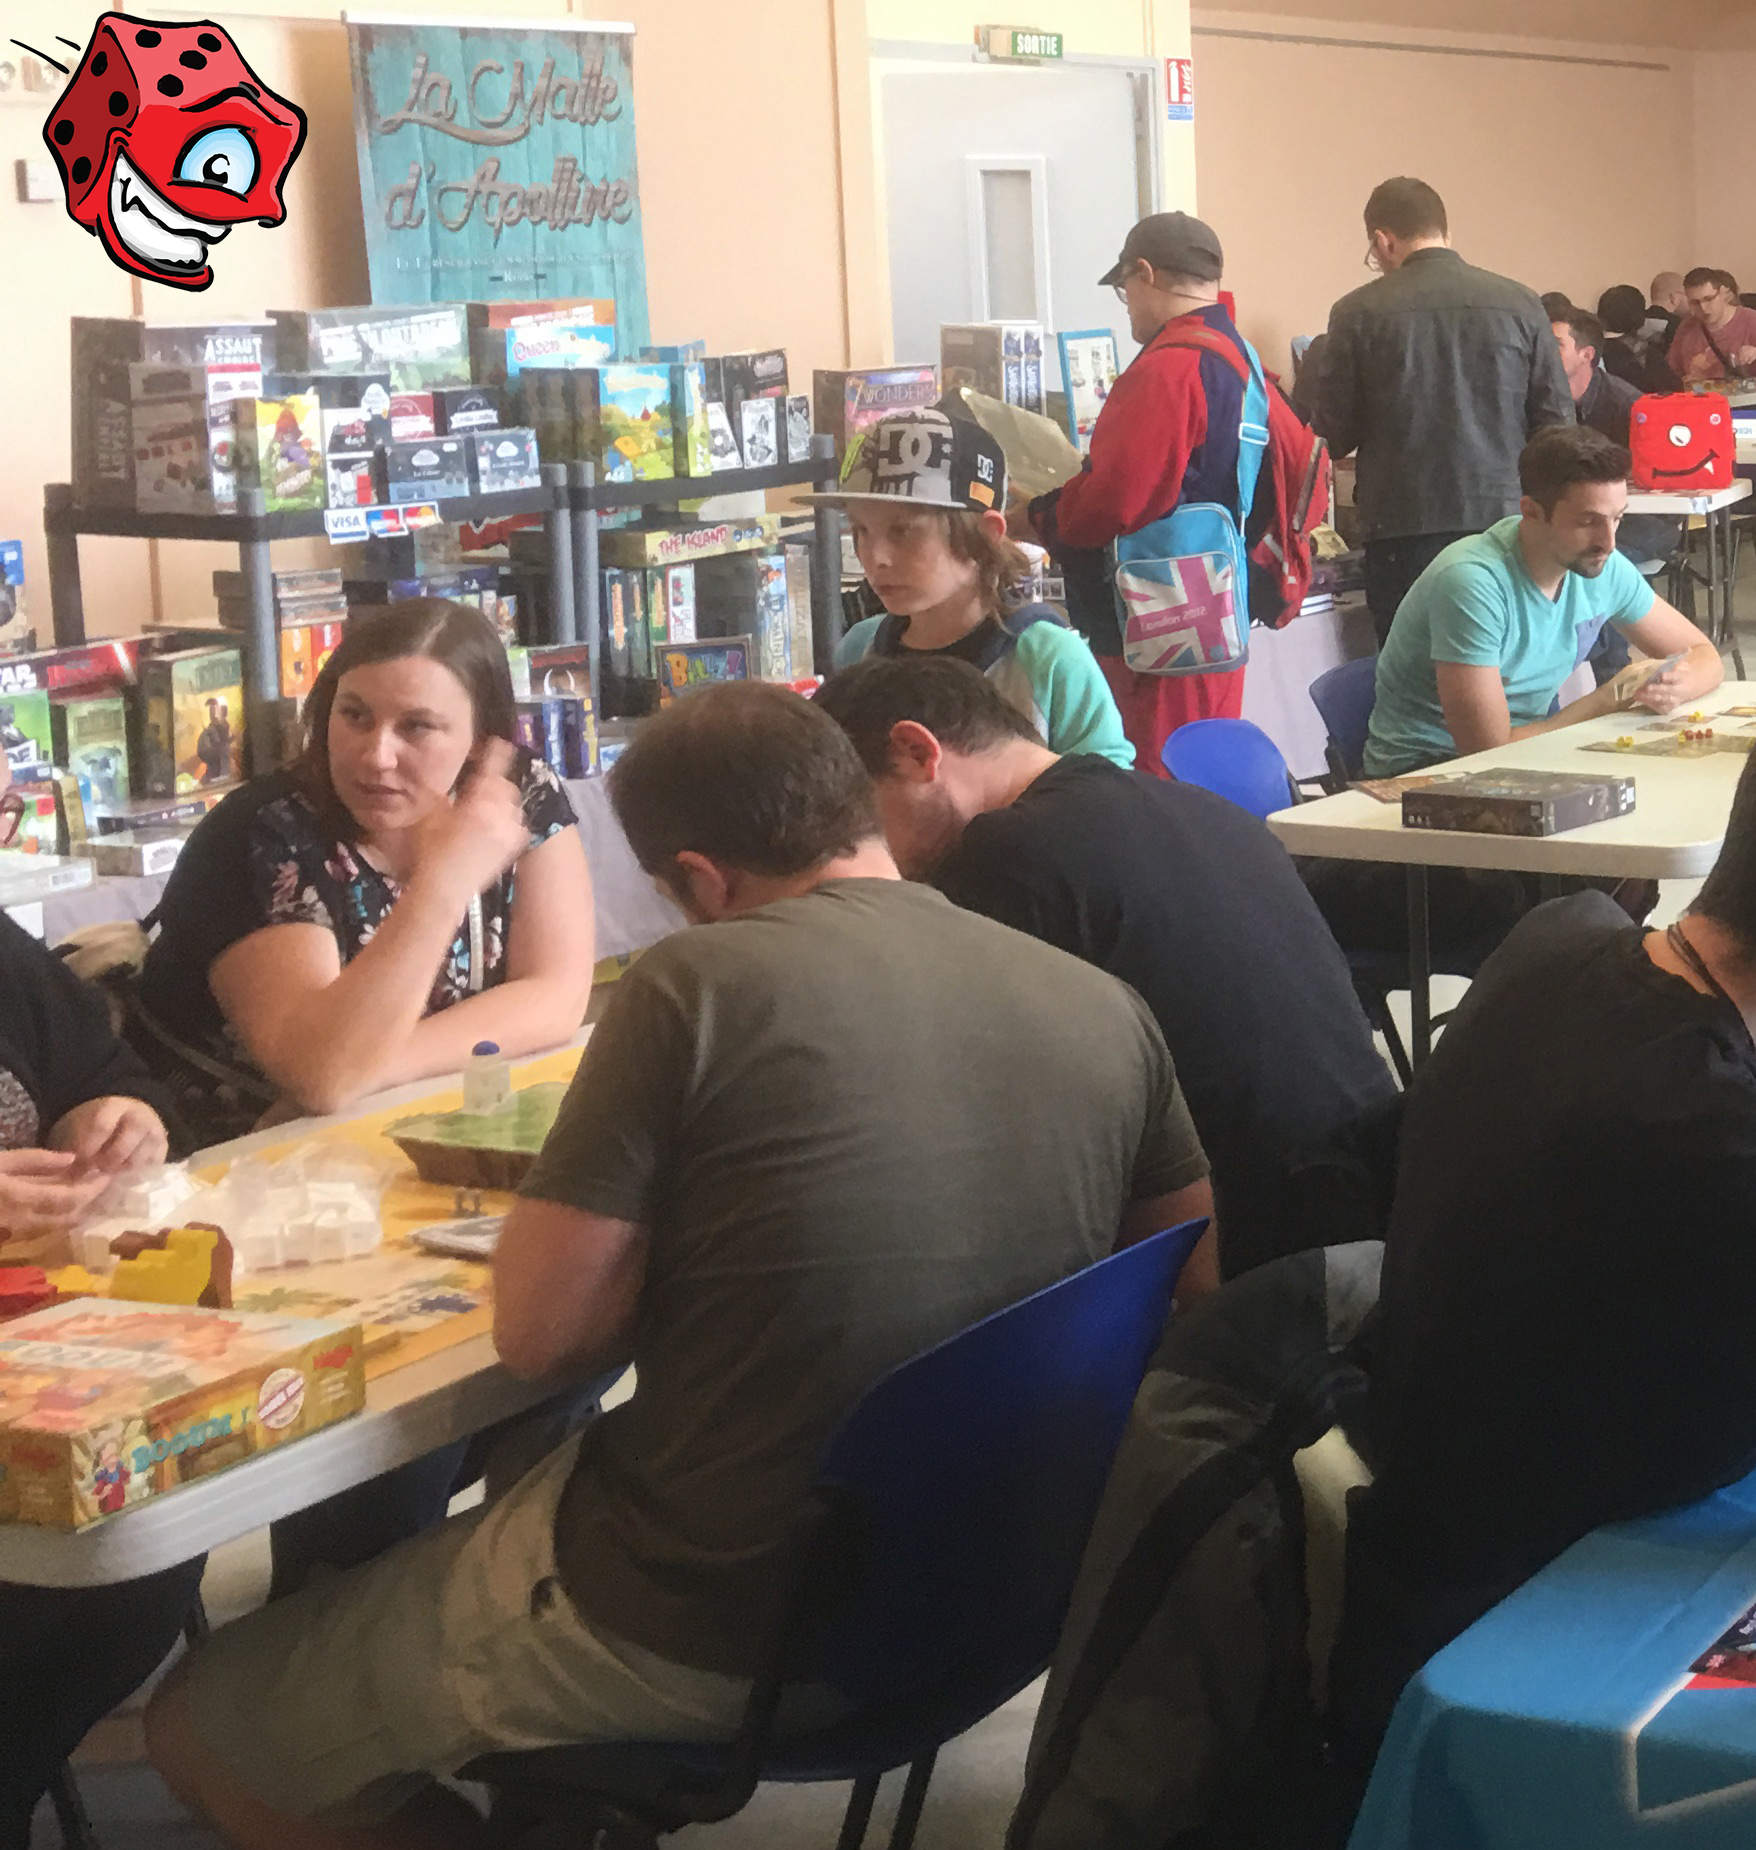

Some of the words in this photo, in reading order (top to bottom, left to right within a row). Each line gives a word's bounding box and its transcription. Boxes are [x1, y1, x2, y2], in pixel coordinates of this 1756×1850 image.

[1016, 33, 1058, 56] SORTIE
[204, 336, 263, 363] ASSAUT
[977, 453, 994, 483] DC
[331, 514, 361, 529] VISA
[658, 534, 682, 554] THE
[1140, 615, 1181, 632] London
[1182, 606, 1207, 620] 2012
[0, 663, 32, 685] AR
